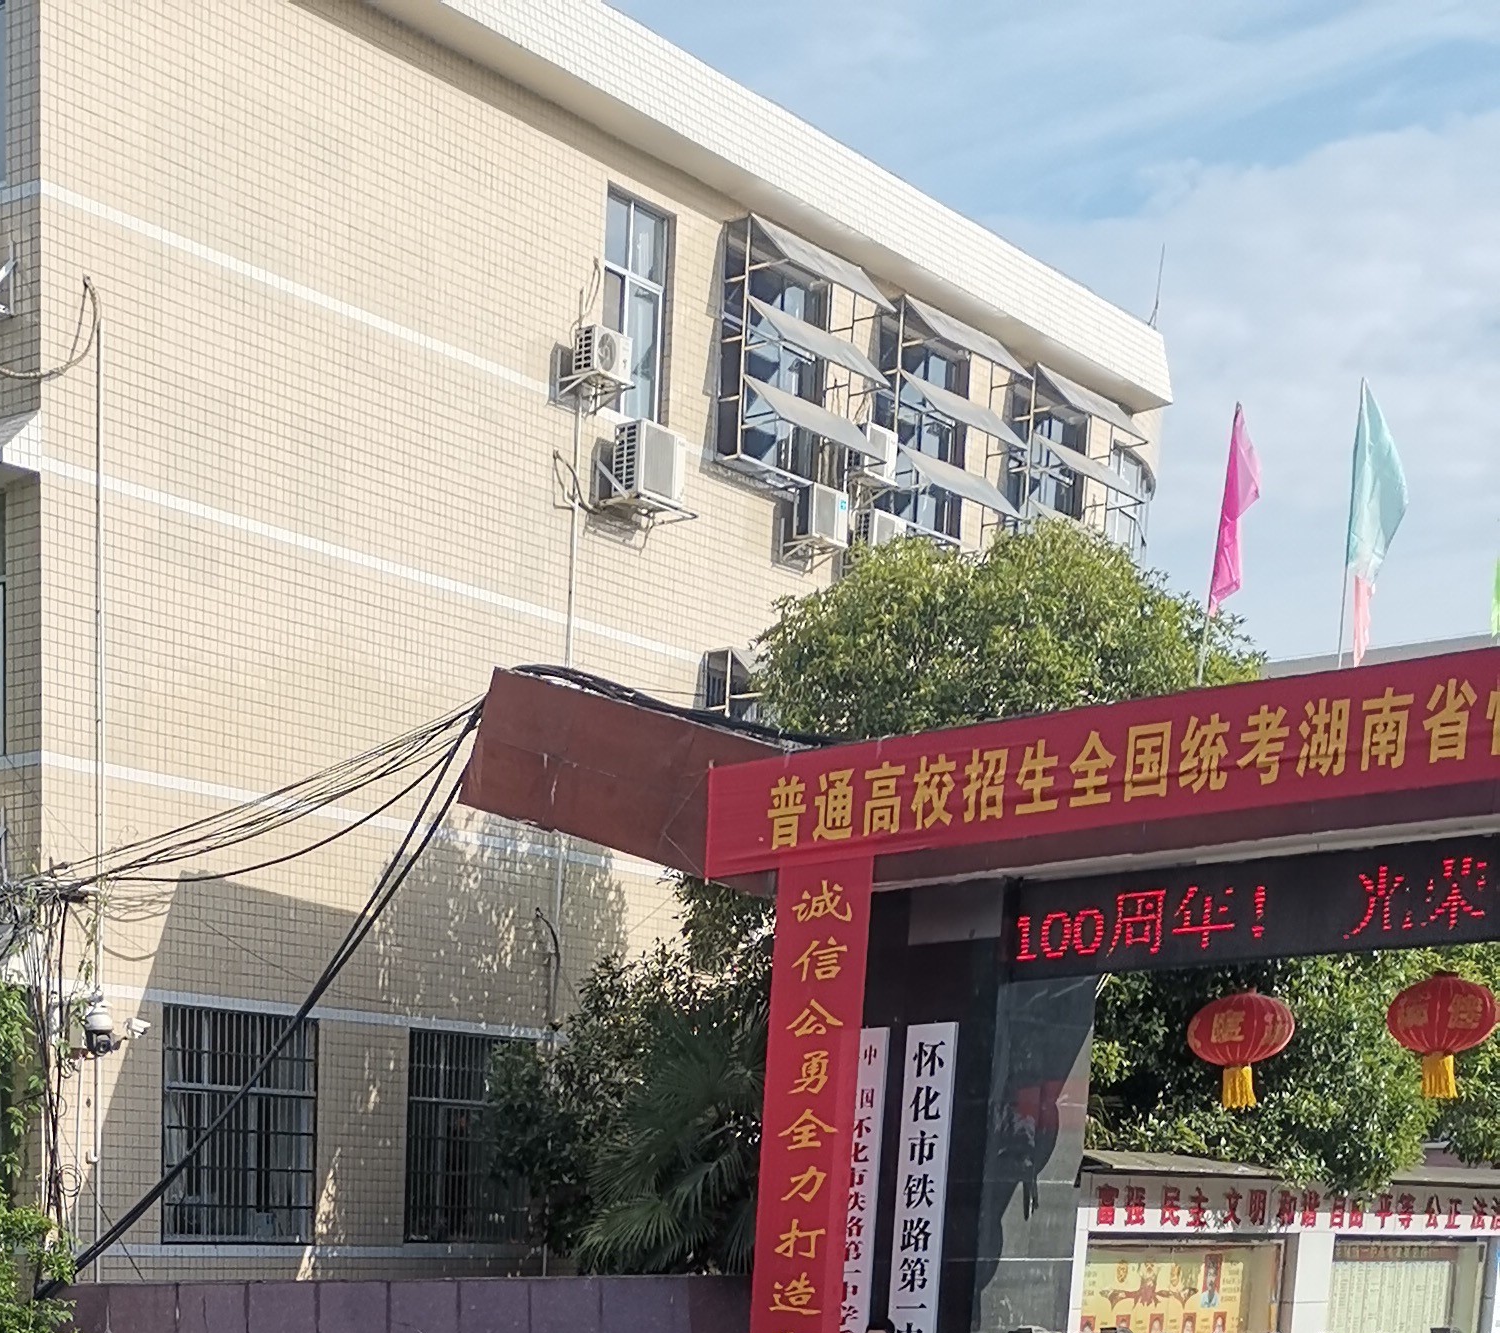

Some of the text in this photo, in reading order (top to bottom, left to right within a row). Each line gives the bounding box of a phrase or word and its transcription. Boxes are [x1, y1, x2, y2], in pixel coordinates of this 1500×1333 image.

[1096, 1183, 1146, 1227] 富强
[1160, 1185, 1208, 1228] 民主
[1223, 1187, 1267, 1227] 文明
[1375, 1192, 1416, 1230] 平等
[1425, 1193, 1462, 1230] 公正
